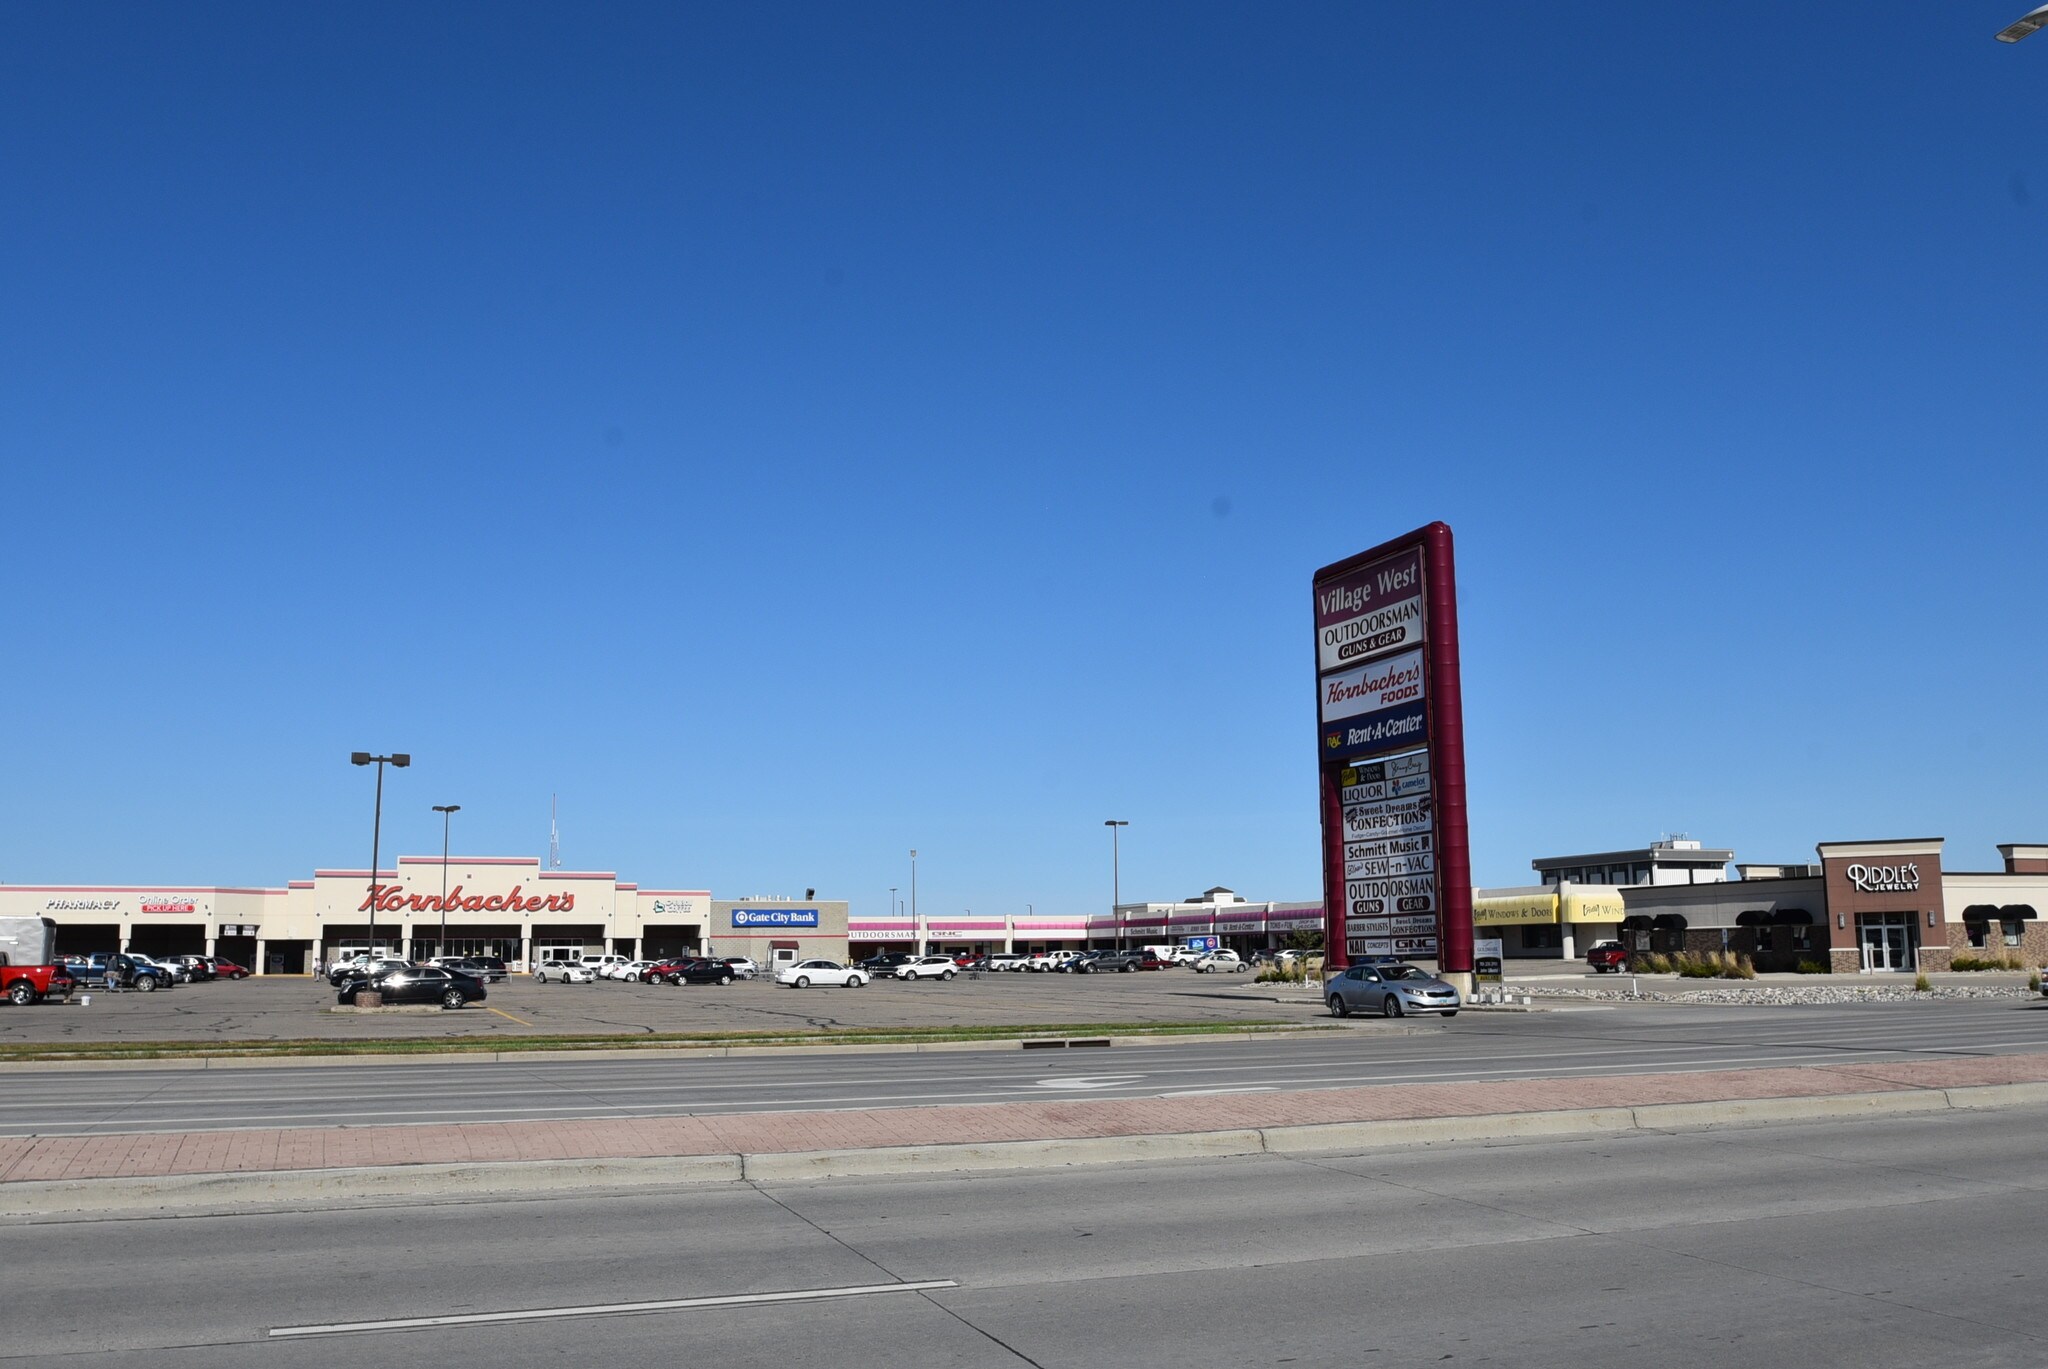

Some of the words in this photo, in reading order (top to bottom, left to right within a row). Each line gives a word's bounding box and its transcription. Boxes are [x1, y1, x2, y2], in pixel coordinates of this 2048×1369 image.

[1320, 584, 1371, 616] Village
[1377, 562, 1416, 595] West
[1325, 599, 1419, 646] OUTDOORSMAN
[1341, 640, 1367, 657] GUNS
[1370, 638, 1377, 649] &
[1378, 629, 1402, 646] GEAR
[1326, 660, 1420, 705] Hornbacher's
[1381, 684, 1419, 704] FOODS
[1402, 777, 1425, 789] camelot
[1344, 785, 1383, 802] LIQUOR
[1359, 804, 1382, 817] Sweet
[1386, 801, 1417, 814] Dreams
[1351, 810, 1426, 831] CONFECTIONS
[1349, 841, 1386, 859] Schmitt
[1390, 838, 1419, 854] Music
[1847, 863, 1919, 891] RIDDLE'S
[1350, 877, 1433, 899] OUTDOORSMAN
[46, 900, 120, 910] PHARMACY
[138, 896, 169, 905] Online
[172, 896, 199, 905] Order
[358, 885, 575, 912] Hornbacher's
[1357, 900, 1380, 913] GUNS
[1402, 897, 1424, 910] GEAR
[749, 912, 770, 922] Gate
[771, 912, 790, 924] City
[790, 912, 815, 922] Bank
[1488, 909, 1519, 919] WINDOWS
[1521, 908, 1528, 917] &
[1531, 907, 1552, 917] DOORS
[1347, 923, 1366, 932] BARBER
[1366, 922, 1389, 931] STYLISTS
[1349, 940, 1367, 954] NAIL
[1367, 941, 1389, 949] CONCEPTS
[1395, 938, 1437, 948] GNC
